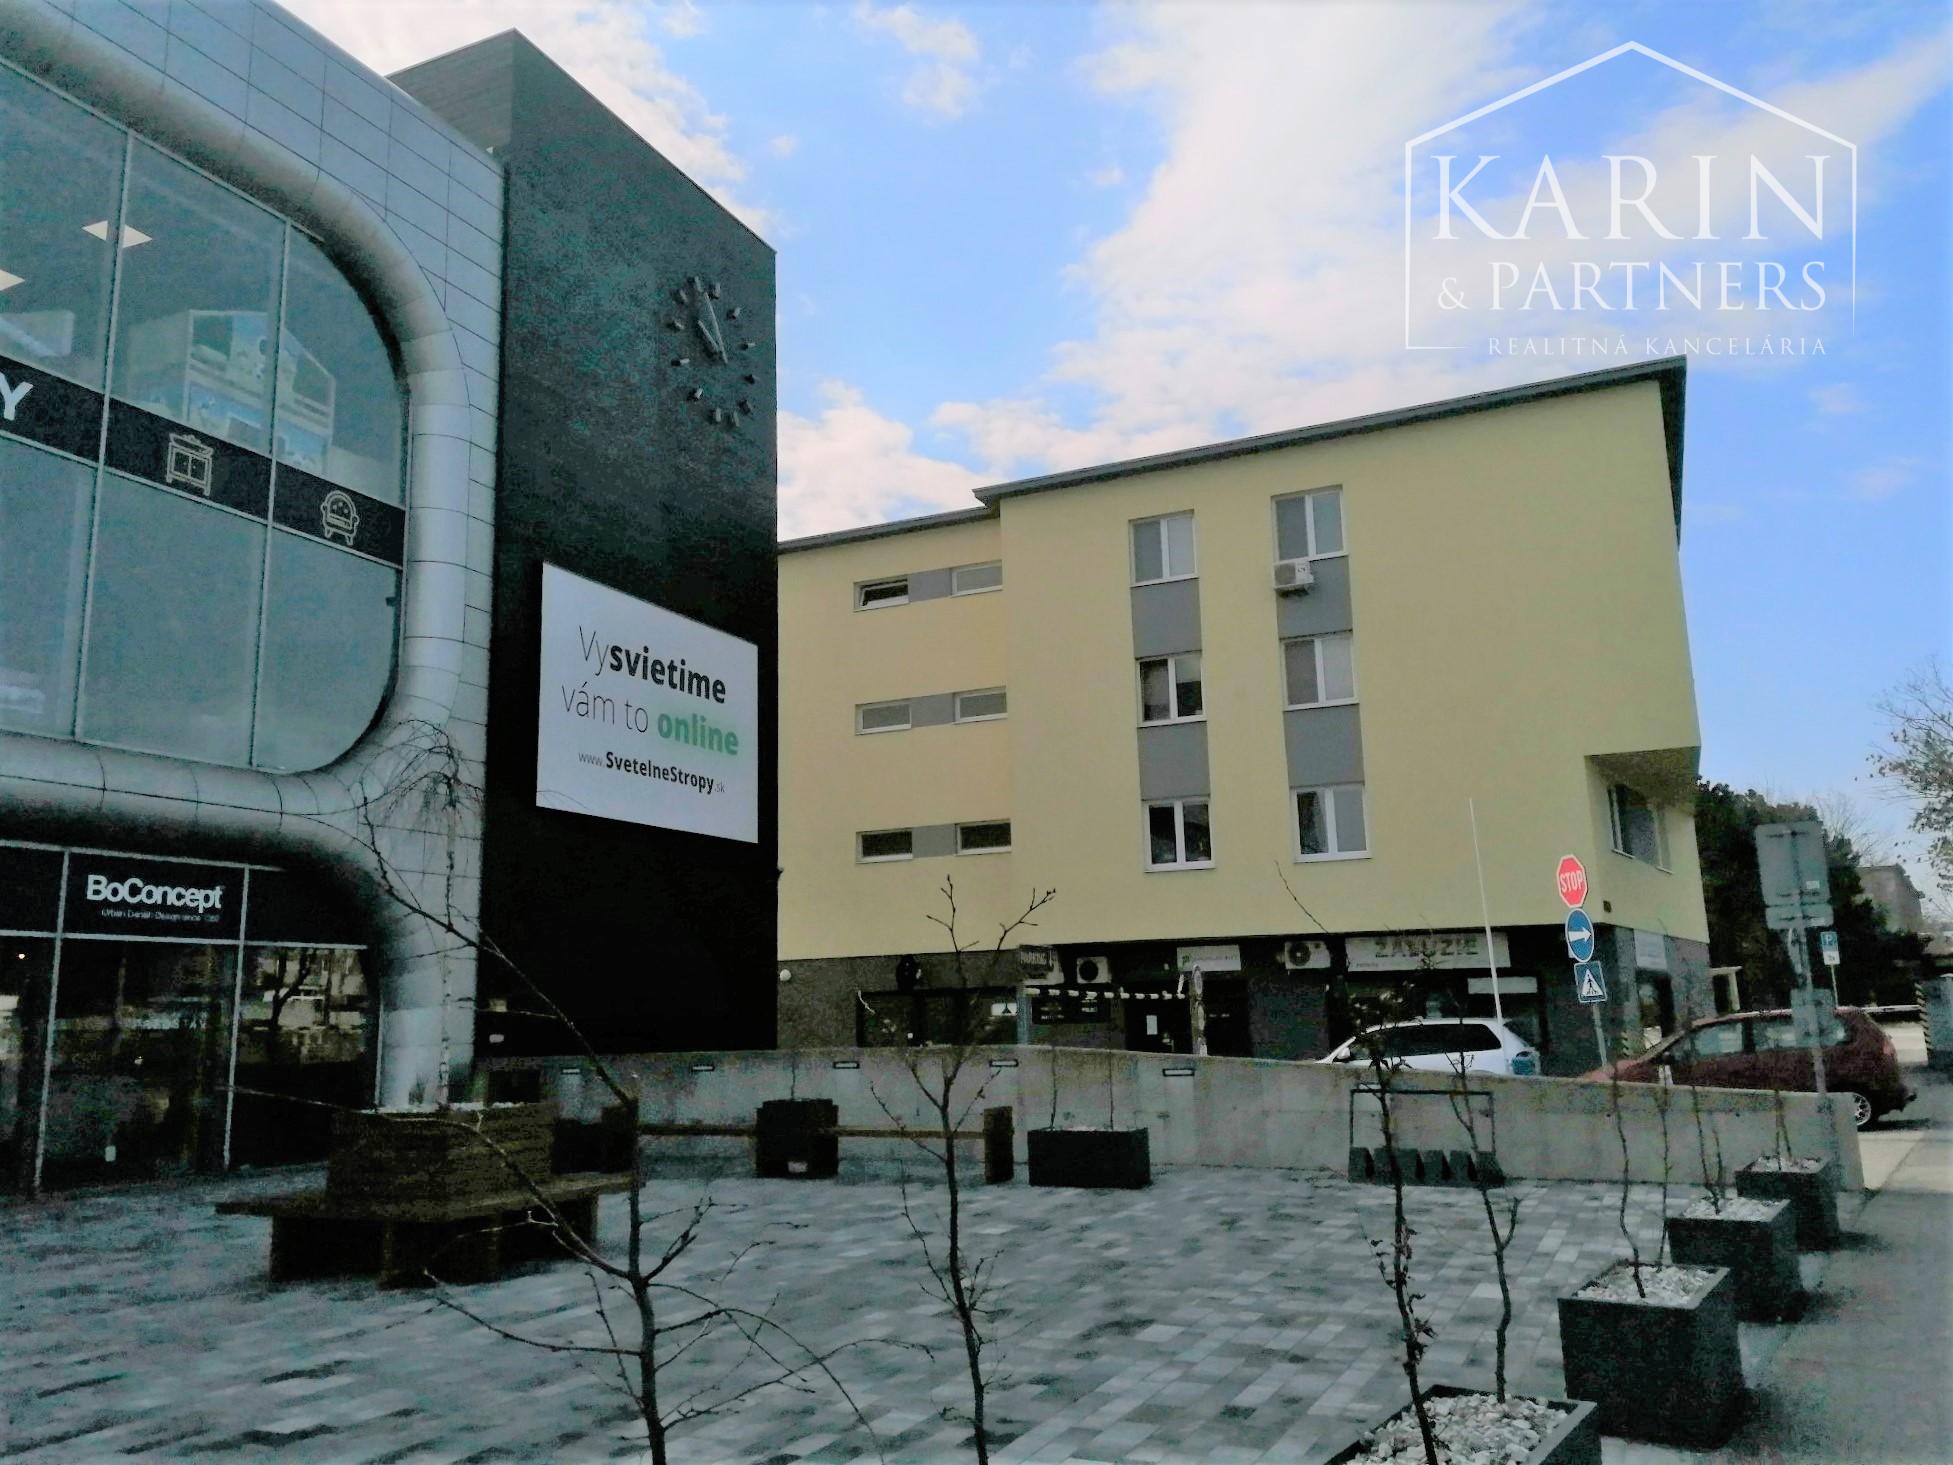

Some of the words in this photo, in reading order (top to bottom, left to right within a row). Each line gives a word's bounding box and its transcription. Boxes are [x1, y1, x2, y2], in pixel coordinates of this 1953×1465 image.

[578, 625, 727, 704] Vysvietime
[562, 681, 615, 726] vám
[624, 702, 650, 734] to
[657, 712, 740, 756] online
[578, 751, 726, 795] www.SvetelneStropy.sk
[87, 874, 223, 914] BoConcept
[1560, 870, 1584, 892] STOP
